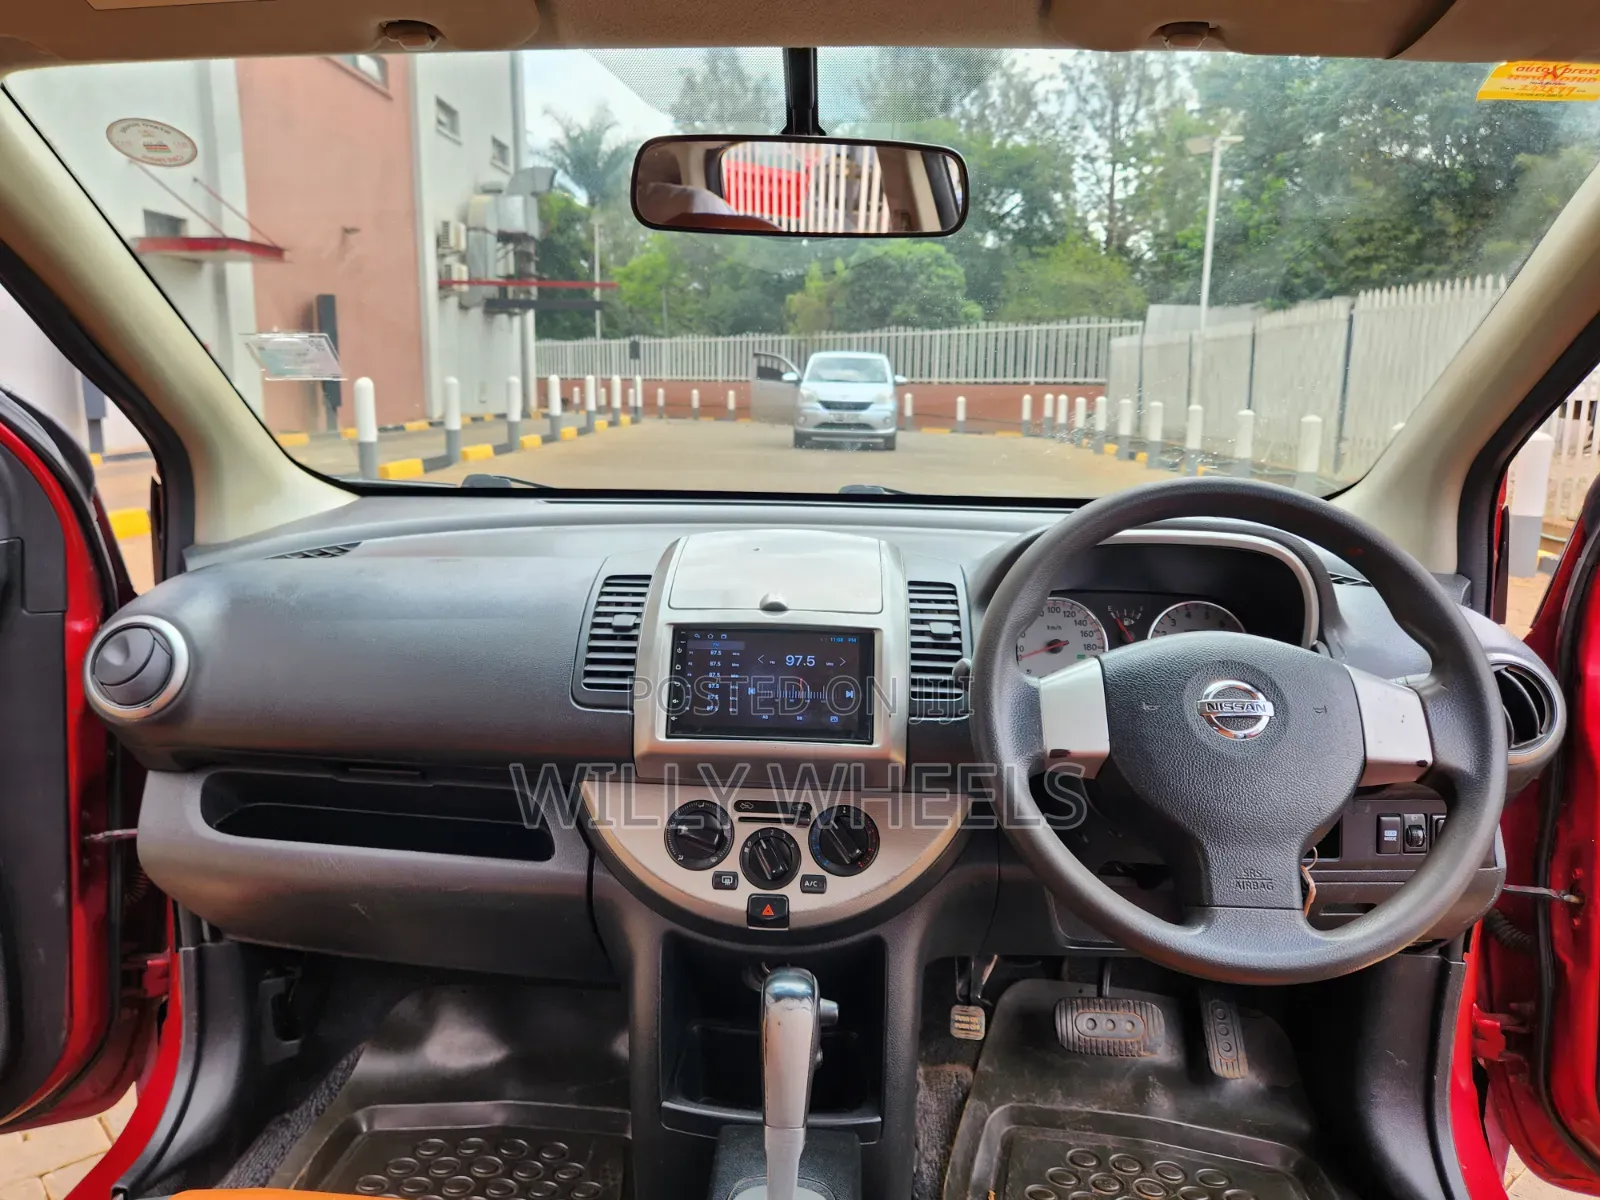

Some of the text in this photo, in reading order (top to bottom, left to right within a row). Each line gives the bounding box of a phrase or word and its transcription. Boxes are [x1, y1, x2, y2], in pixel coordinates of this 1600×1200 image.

[1047, 606, 1061, 614] 100
[1063, 610, 1076, 618] 120
[1074, 619, 1088, 627] 140
[1170, 618, 1177, 627] 3
[1080, 630, 1094, 638] 160
[1083, 643, 1097, 651] 180
[785, 654, 816, 667] 97.5
[1206, 702, 1267, 713] NISSAN
[1243, 869, 1262, 878] SRS
[804, 879, 818, 887] A/C
[1235, 881, 1274, 890] AIRBAG
